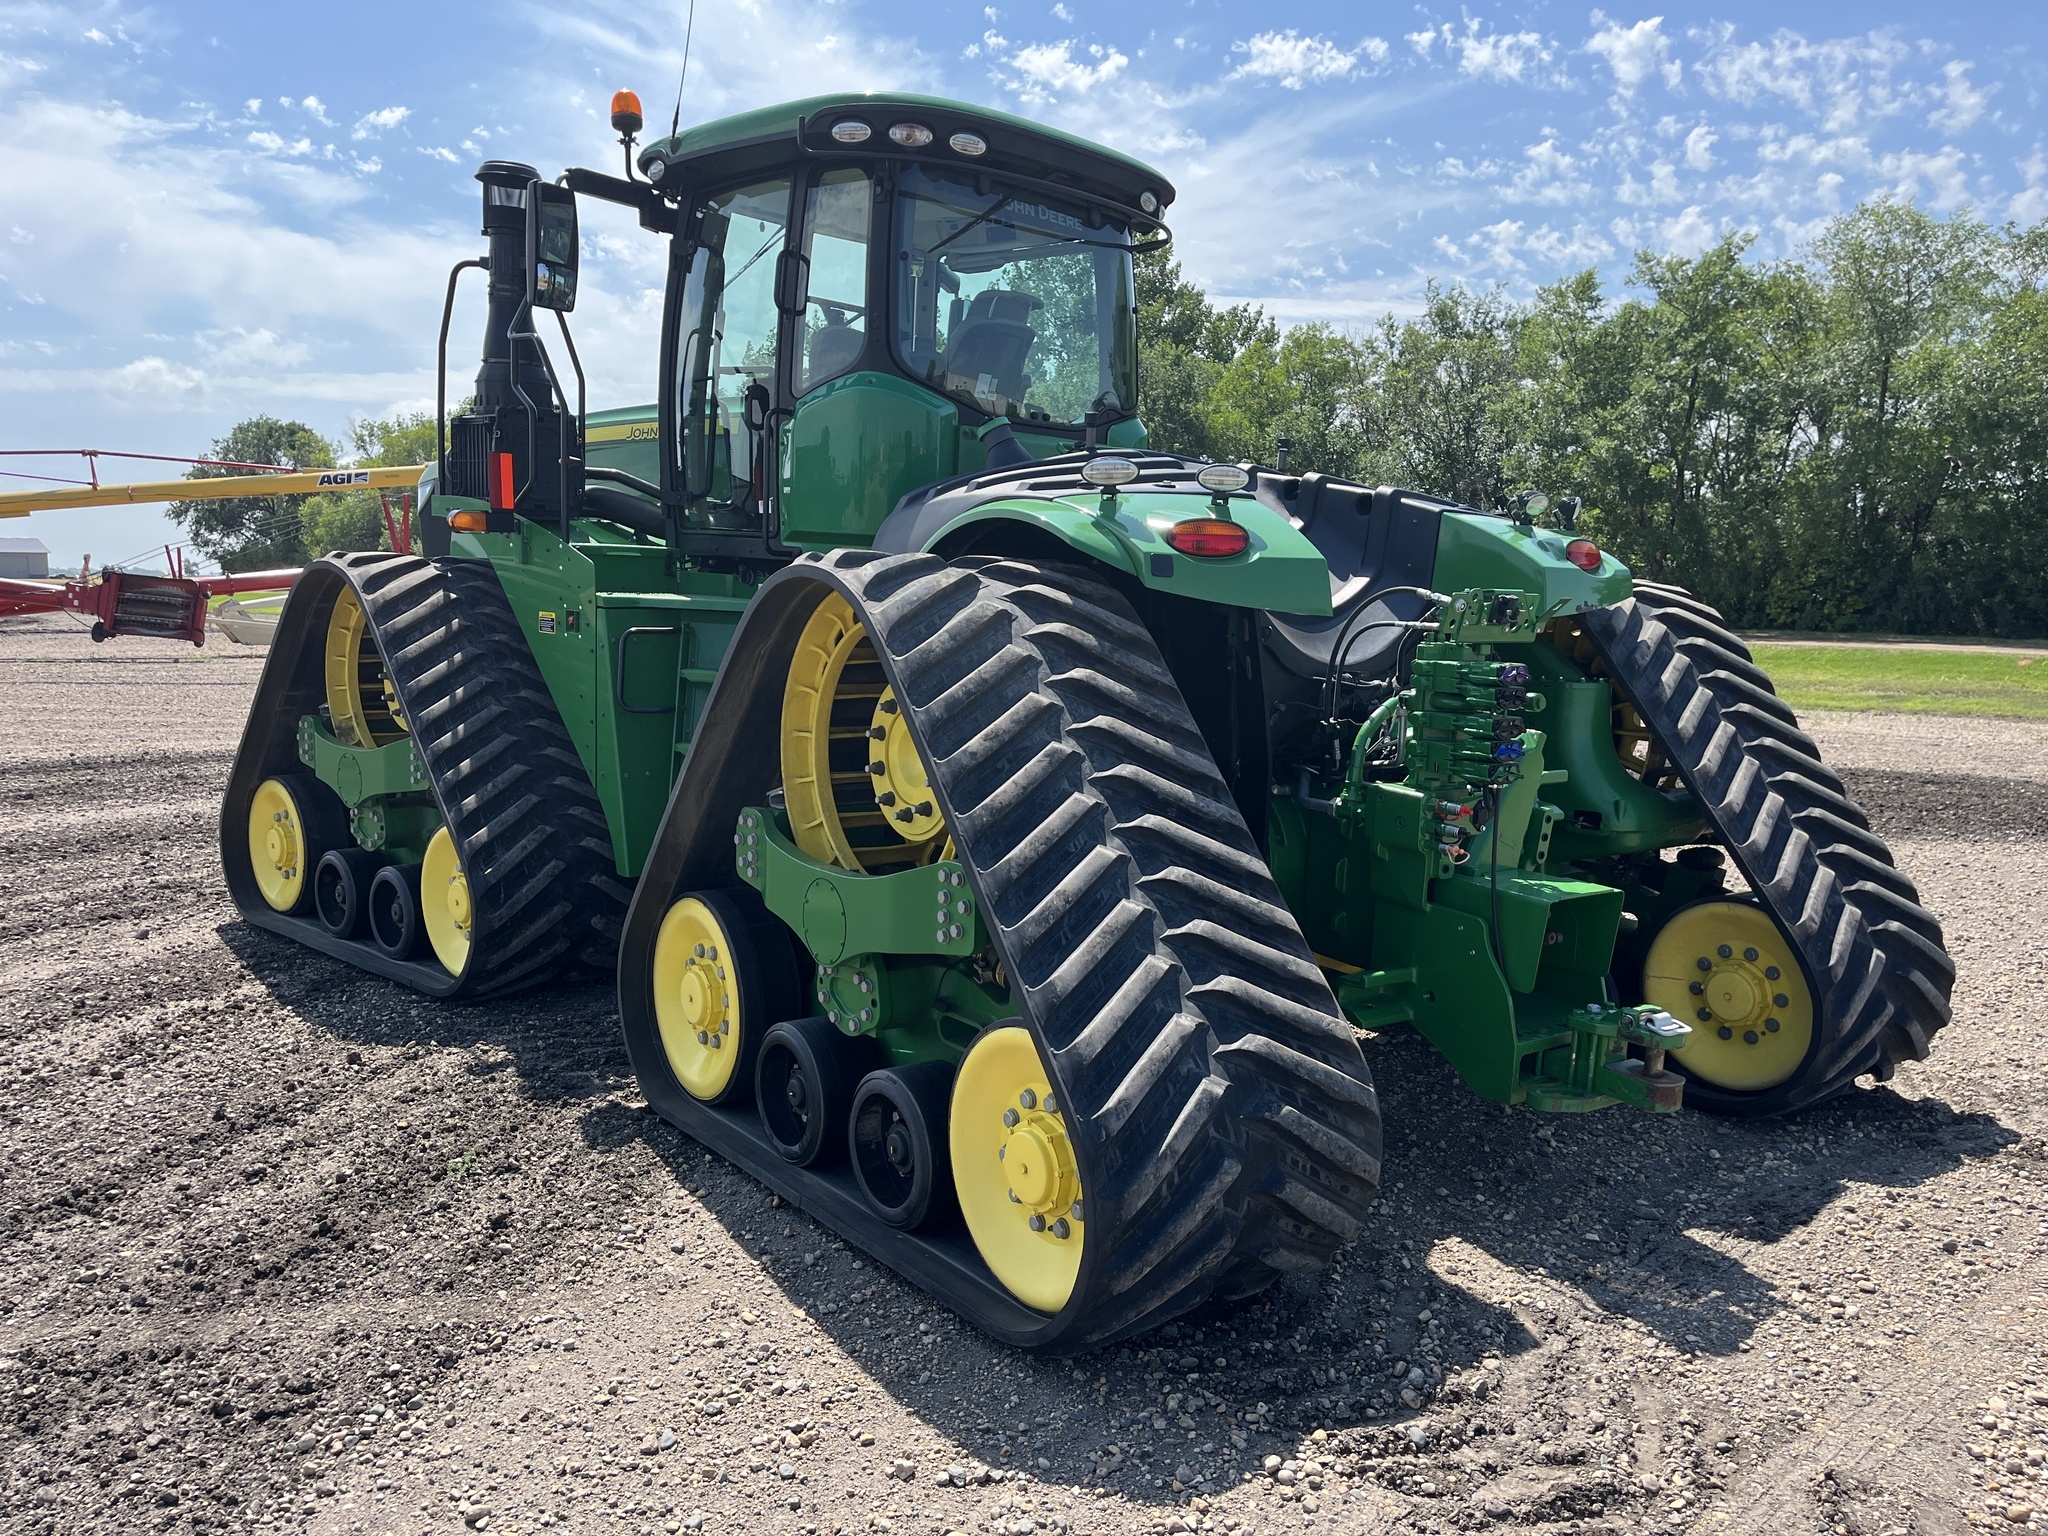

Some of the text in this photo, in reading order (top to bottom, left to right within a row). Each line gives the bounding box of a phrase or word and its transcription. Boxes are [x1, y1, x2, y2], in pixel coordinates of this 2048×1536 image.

[1000, 195, 1083, 231] OHN DEERE
[626, 426, 658, 440] JOHN
[318, 473, 352, 486] AGI
